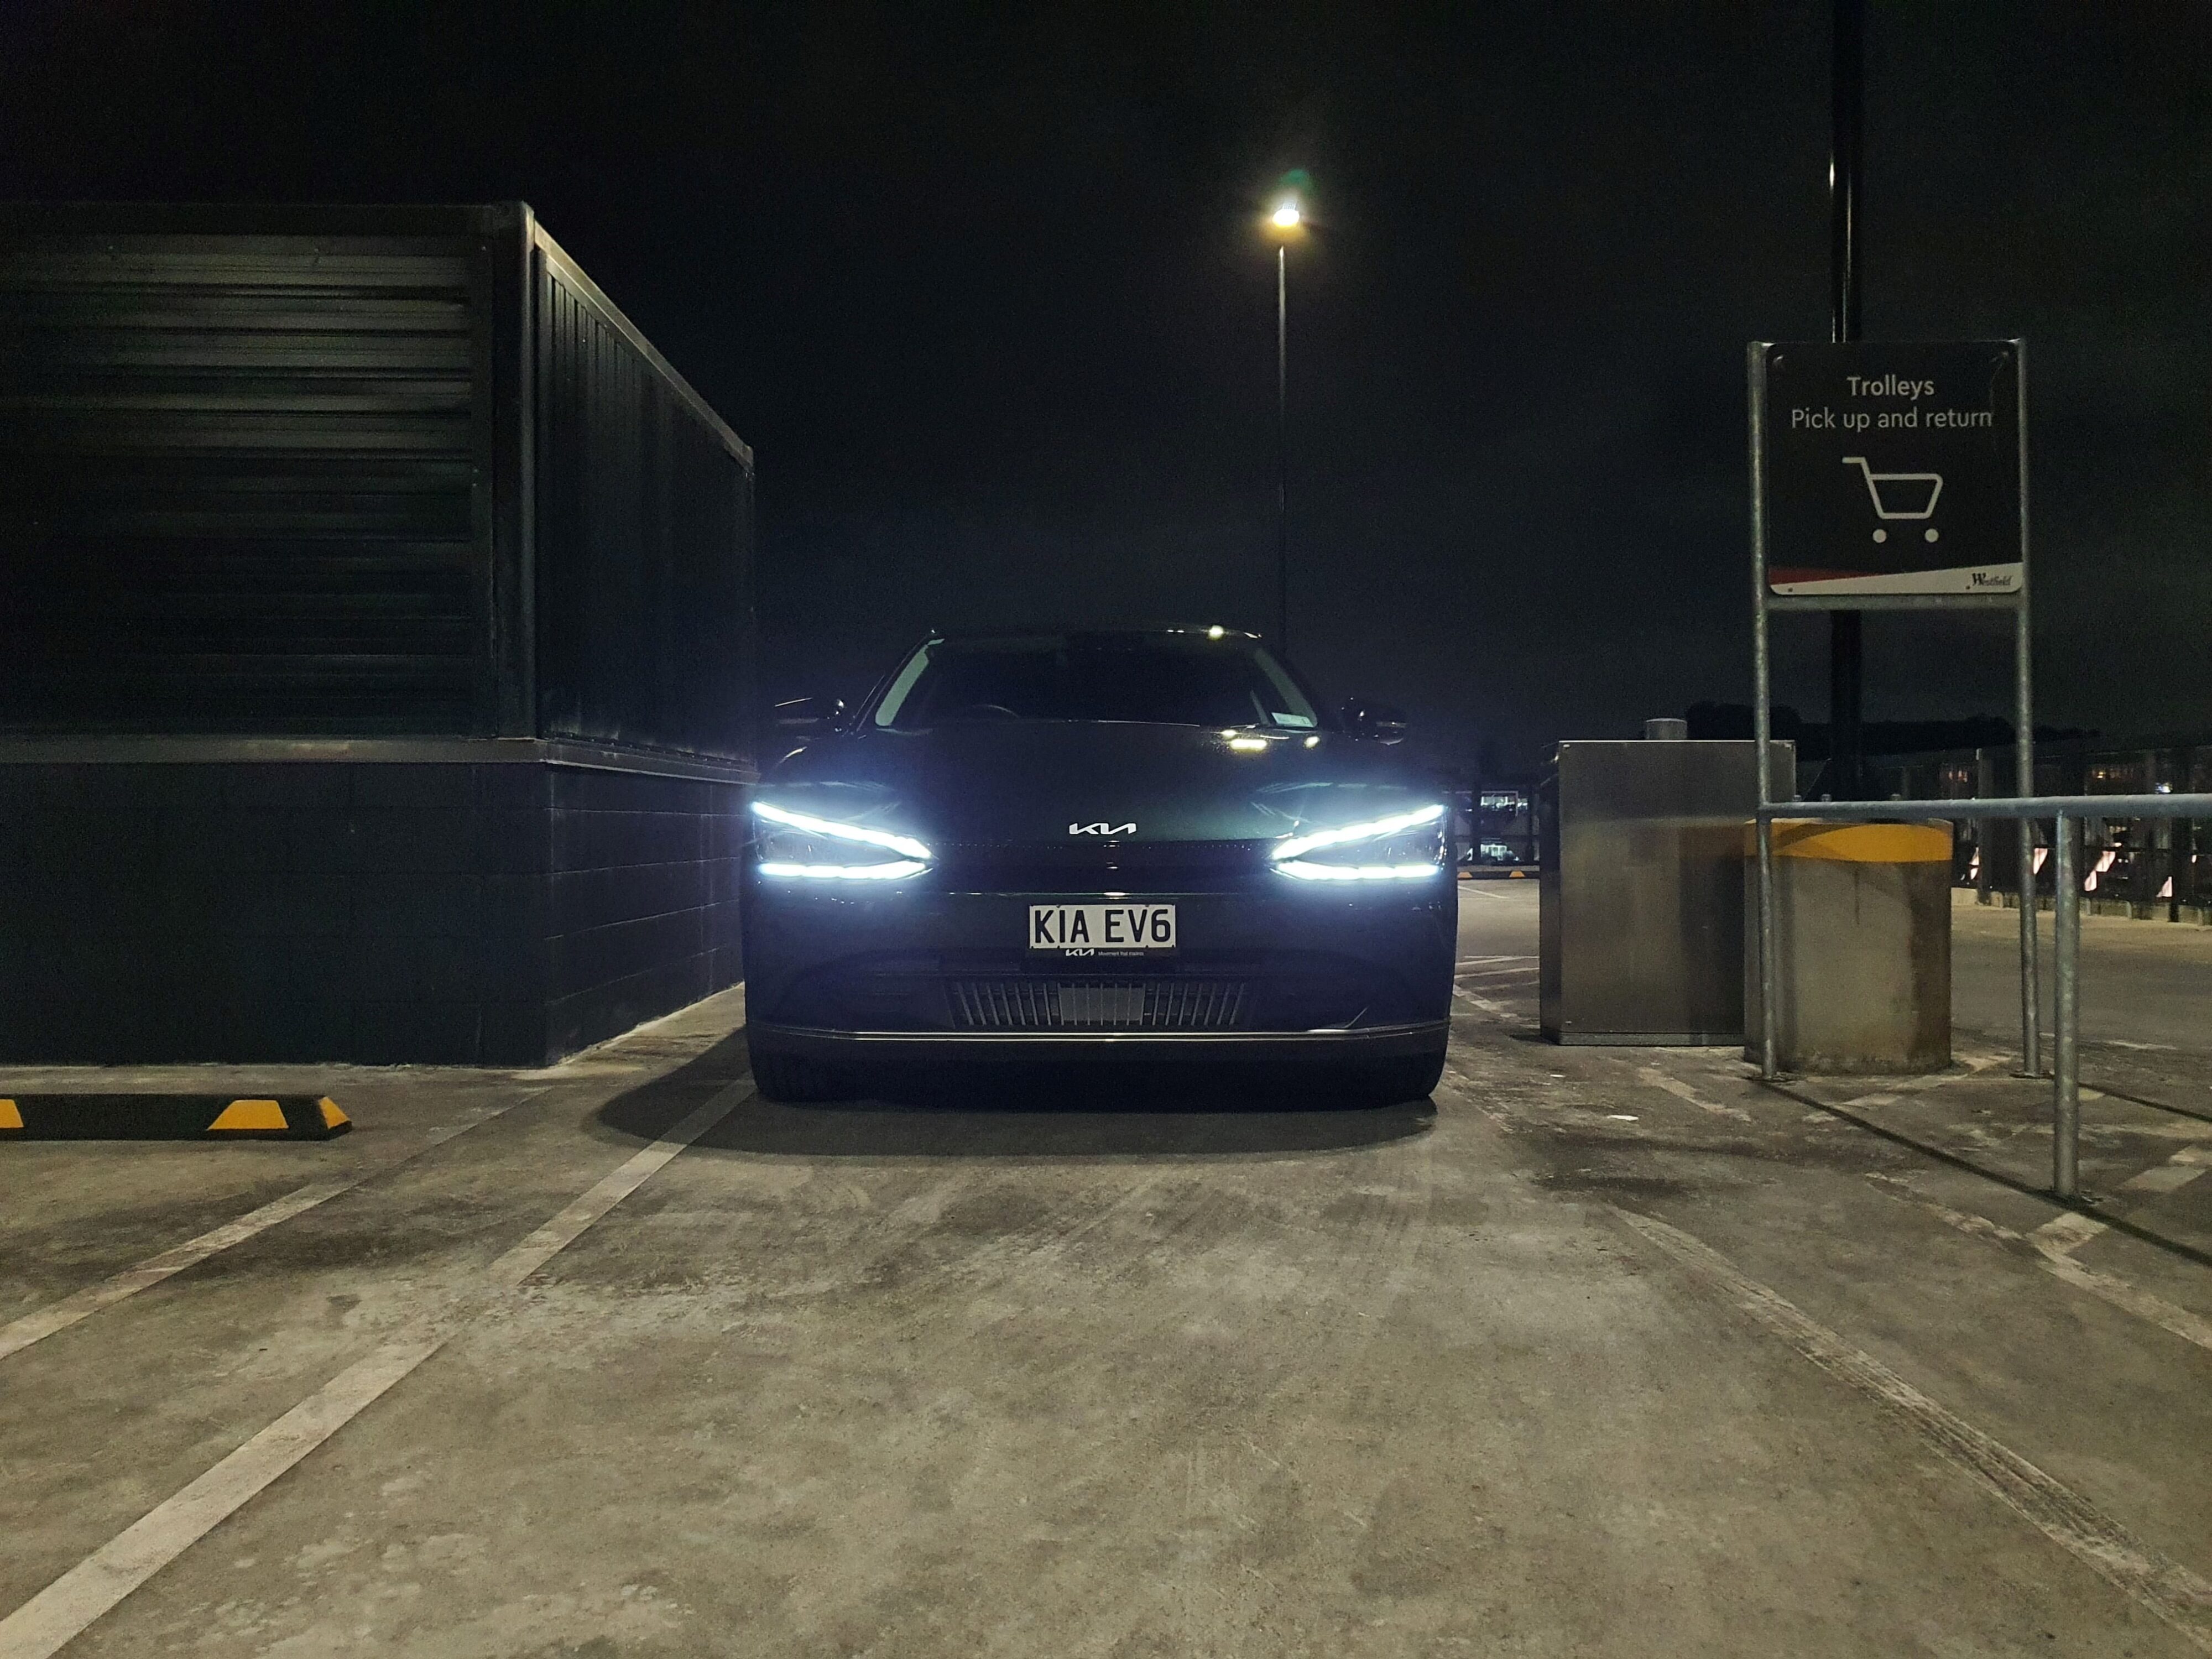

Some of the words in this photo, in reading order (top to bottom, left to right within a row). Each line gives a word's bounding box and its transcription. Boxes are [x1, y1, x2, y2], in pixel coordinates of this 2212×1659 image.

[1846, 374, 1935, 400] Trolleys
[1791, 406, 1836, 429] Pick
[1843, 413, 1870, 432] up
[1878, 406, 1918, 428] and
[1926, 408, 1992, 427] return
[1035, 910, 1090, 943] KIA
[1105, 909, 1171, 943] EV6
